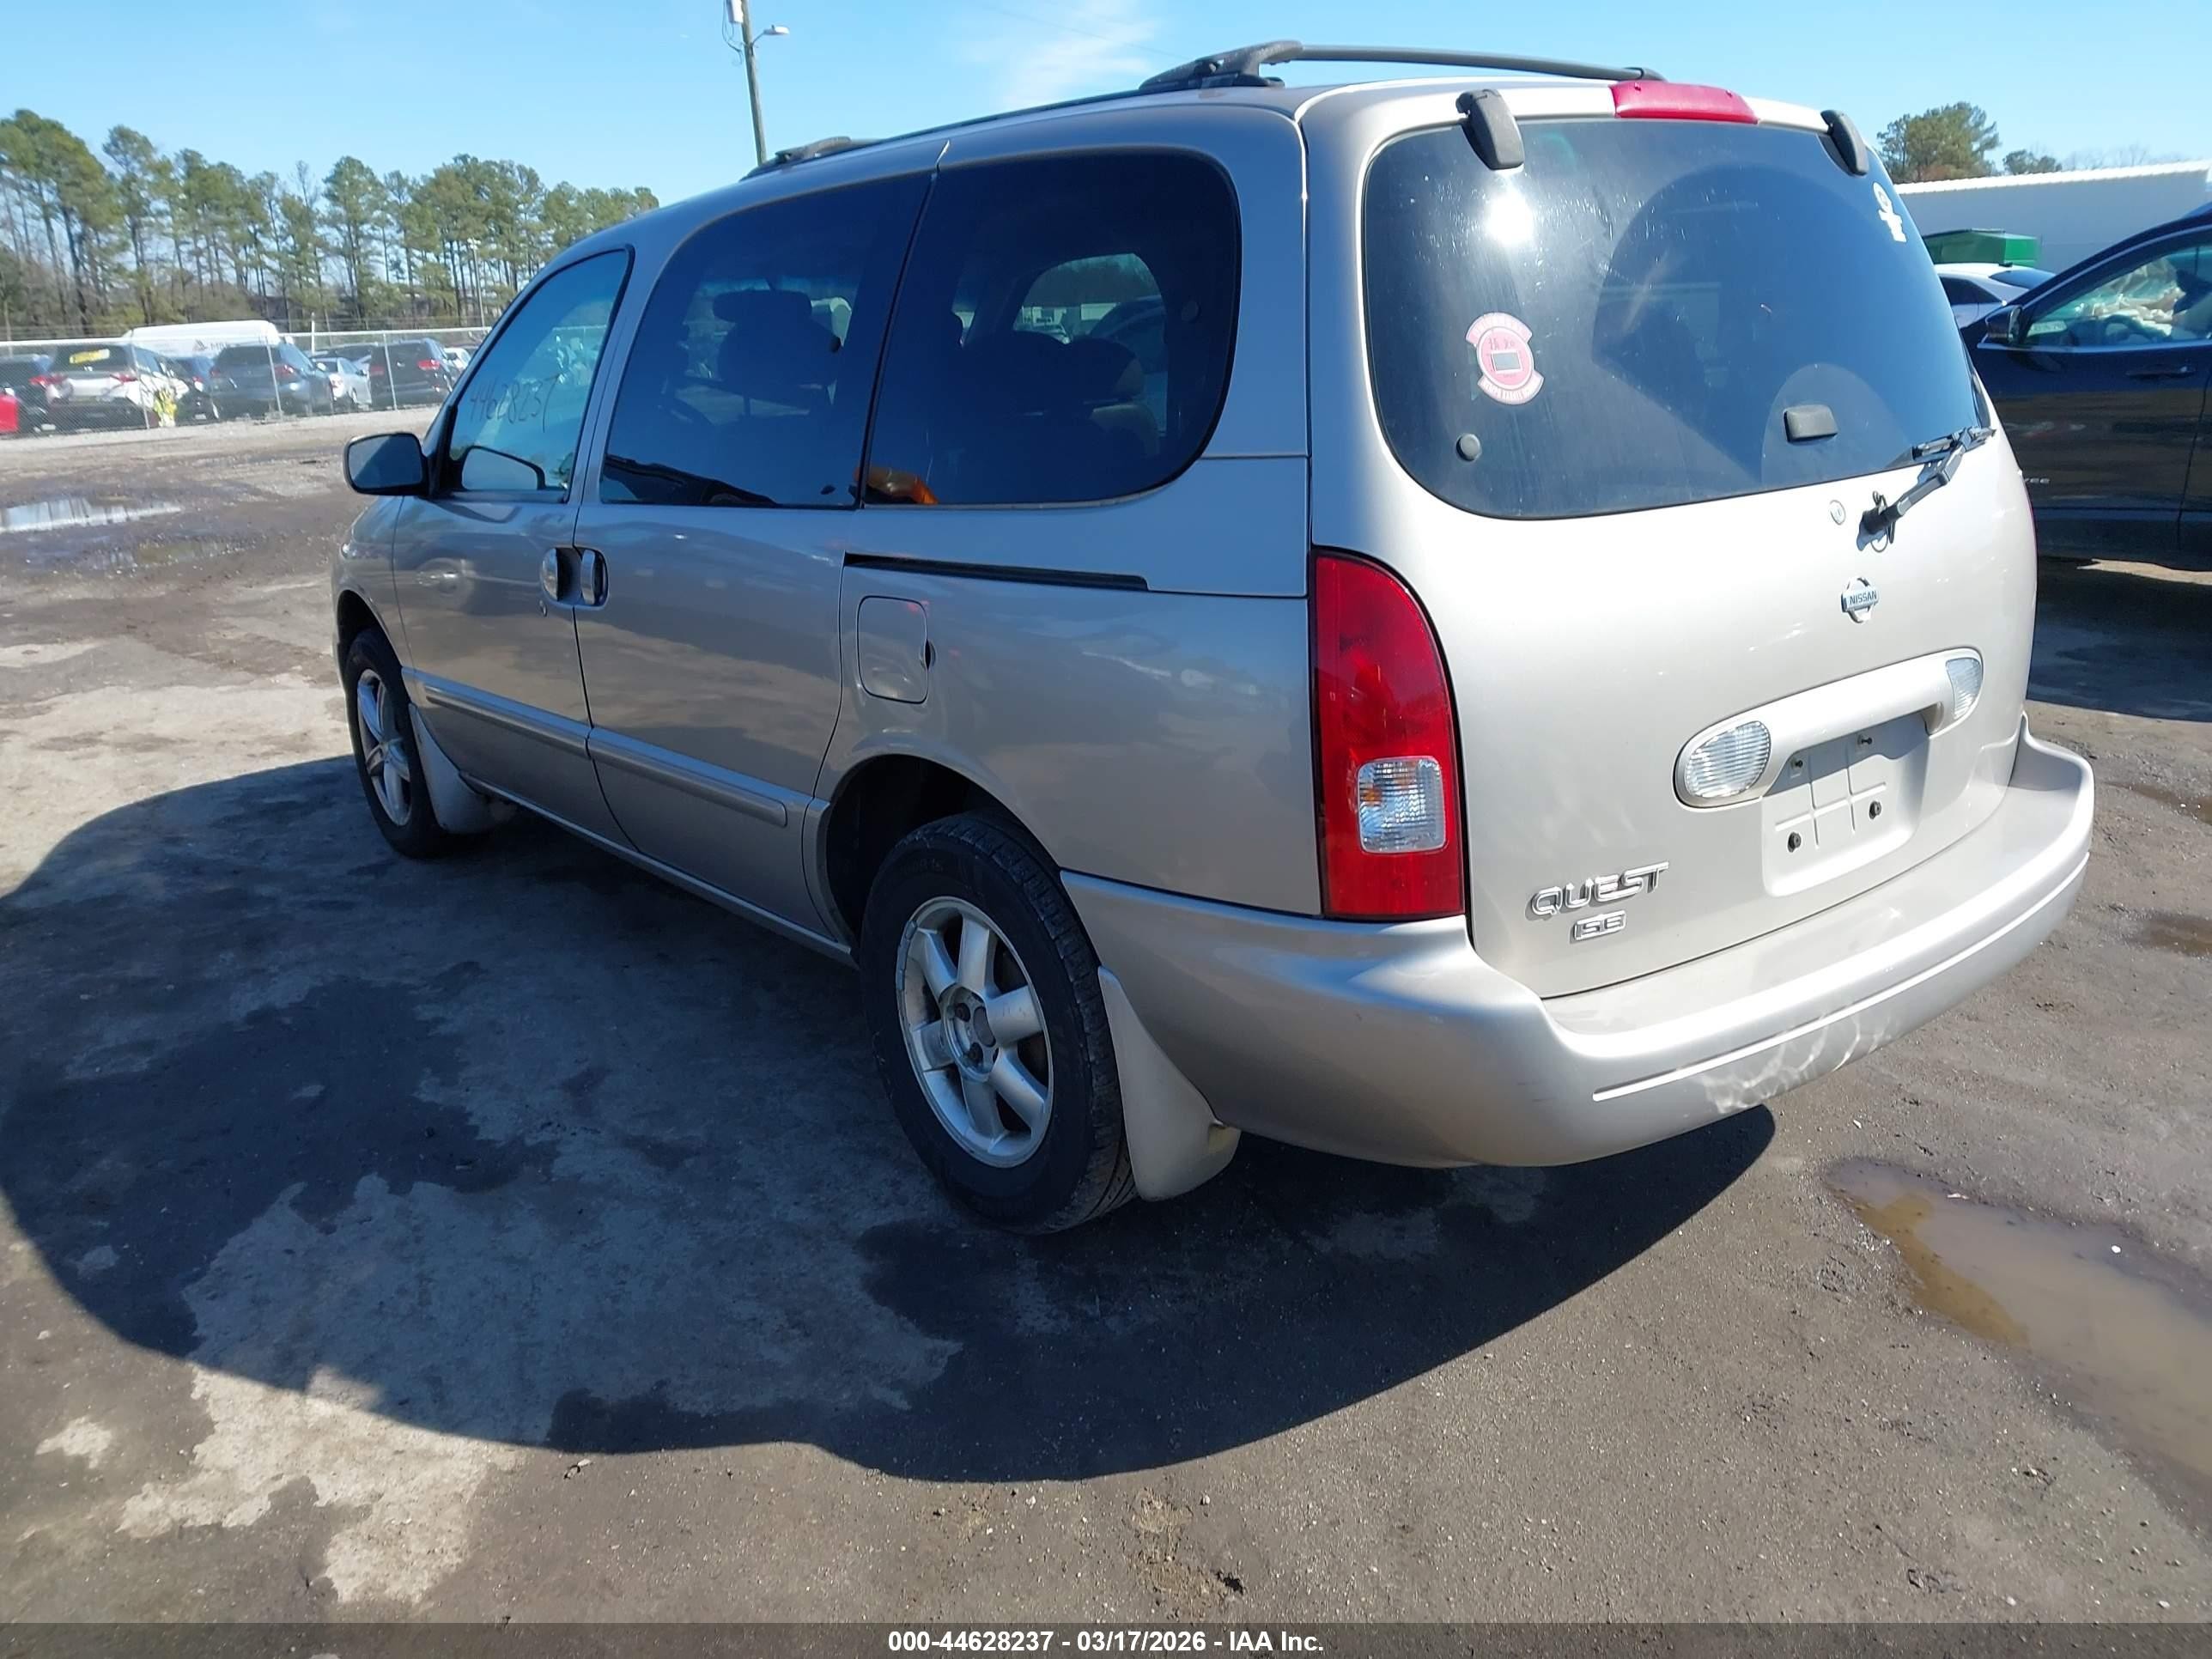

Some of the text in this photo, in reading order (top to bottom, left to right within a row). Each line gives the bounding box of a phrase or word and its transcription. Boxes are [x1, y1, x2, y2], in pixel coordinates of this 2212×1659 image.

[470, 374, 559, 433] 44628237
[1849, 590, 1877, 605] NISSAN
[1530, 860, 1669, 916] QUEST
[1579, 914, 1623, 935] SE
